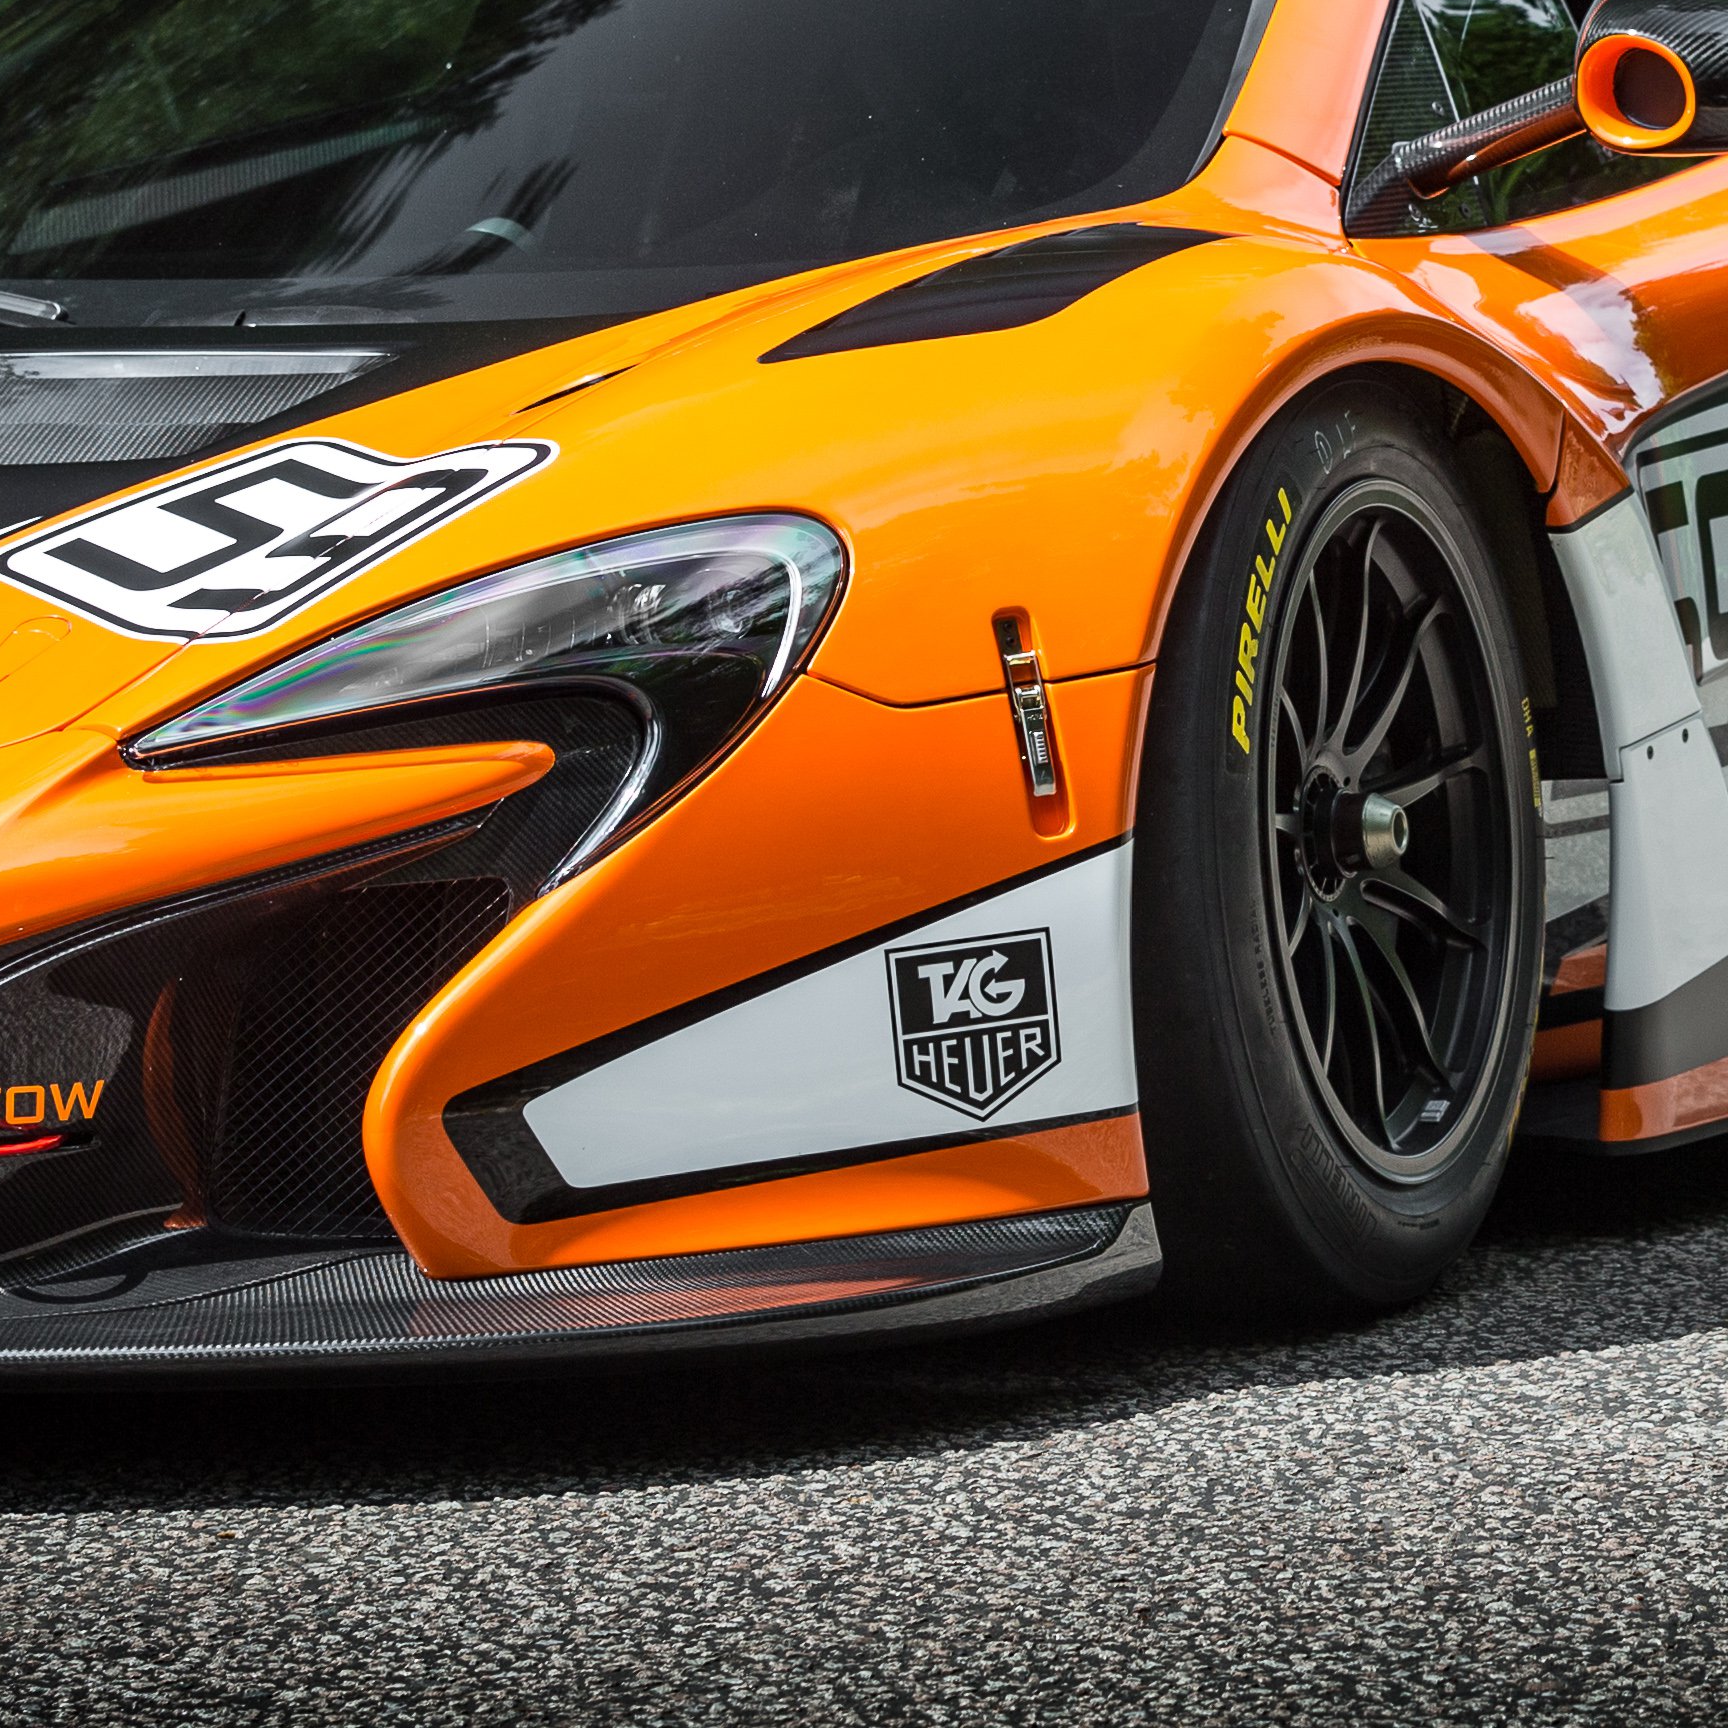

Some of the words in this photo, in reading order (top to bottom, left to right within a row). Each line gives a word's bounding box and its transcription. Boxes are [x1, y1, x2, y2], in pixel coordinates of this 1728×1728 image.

[1231, 486, 1293, 755] PIRELLI
[917, 949, 1026, 1025] TAG
[912, 1026, 1045, 1103] HEUER
